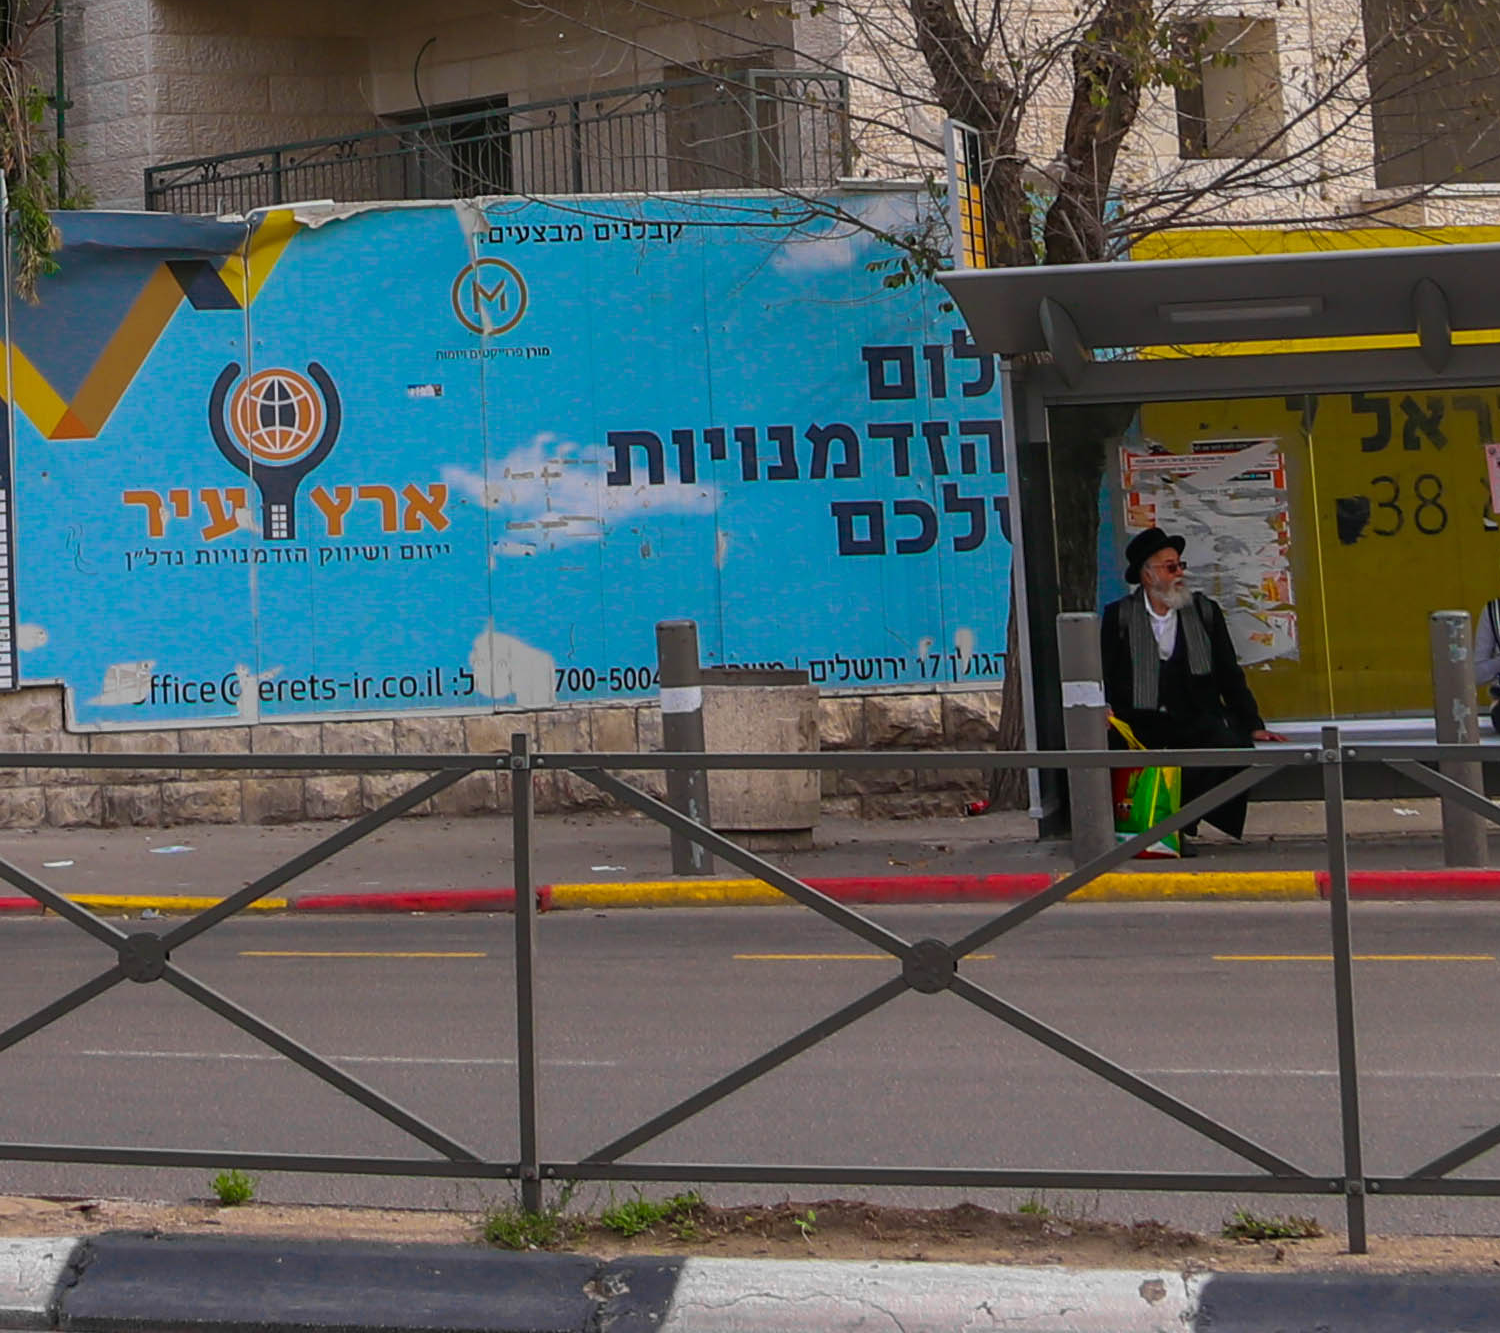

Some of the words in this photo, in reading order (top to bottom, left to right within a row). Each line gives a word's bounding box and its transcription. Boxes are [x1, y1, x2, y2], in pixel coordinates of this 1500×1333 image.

[479, 222, 583, 245] מבצעים:
[595, 219, 683, 245] קבלנים
[525, 345, 551, 359] מורן
[861, 328, 995, 401] לום
[123, 488, 247, 541] עיר
[310, 483, 450, 536] ארץ
[1370, 473, 1449, 536] 38
[124, 547, 186, 572] נדל"ן
[195, 546, 308, 566] הזדמנויות
[319, 544, 390, 564] ושיווק
[401, 543, 451, 560] ייזום
[808, 652, 907, 682] ירושלים
[132, 667, 444, 706] ffice@erets-ir.co.il
